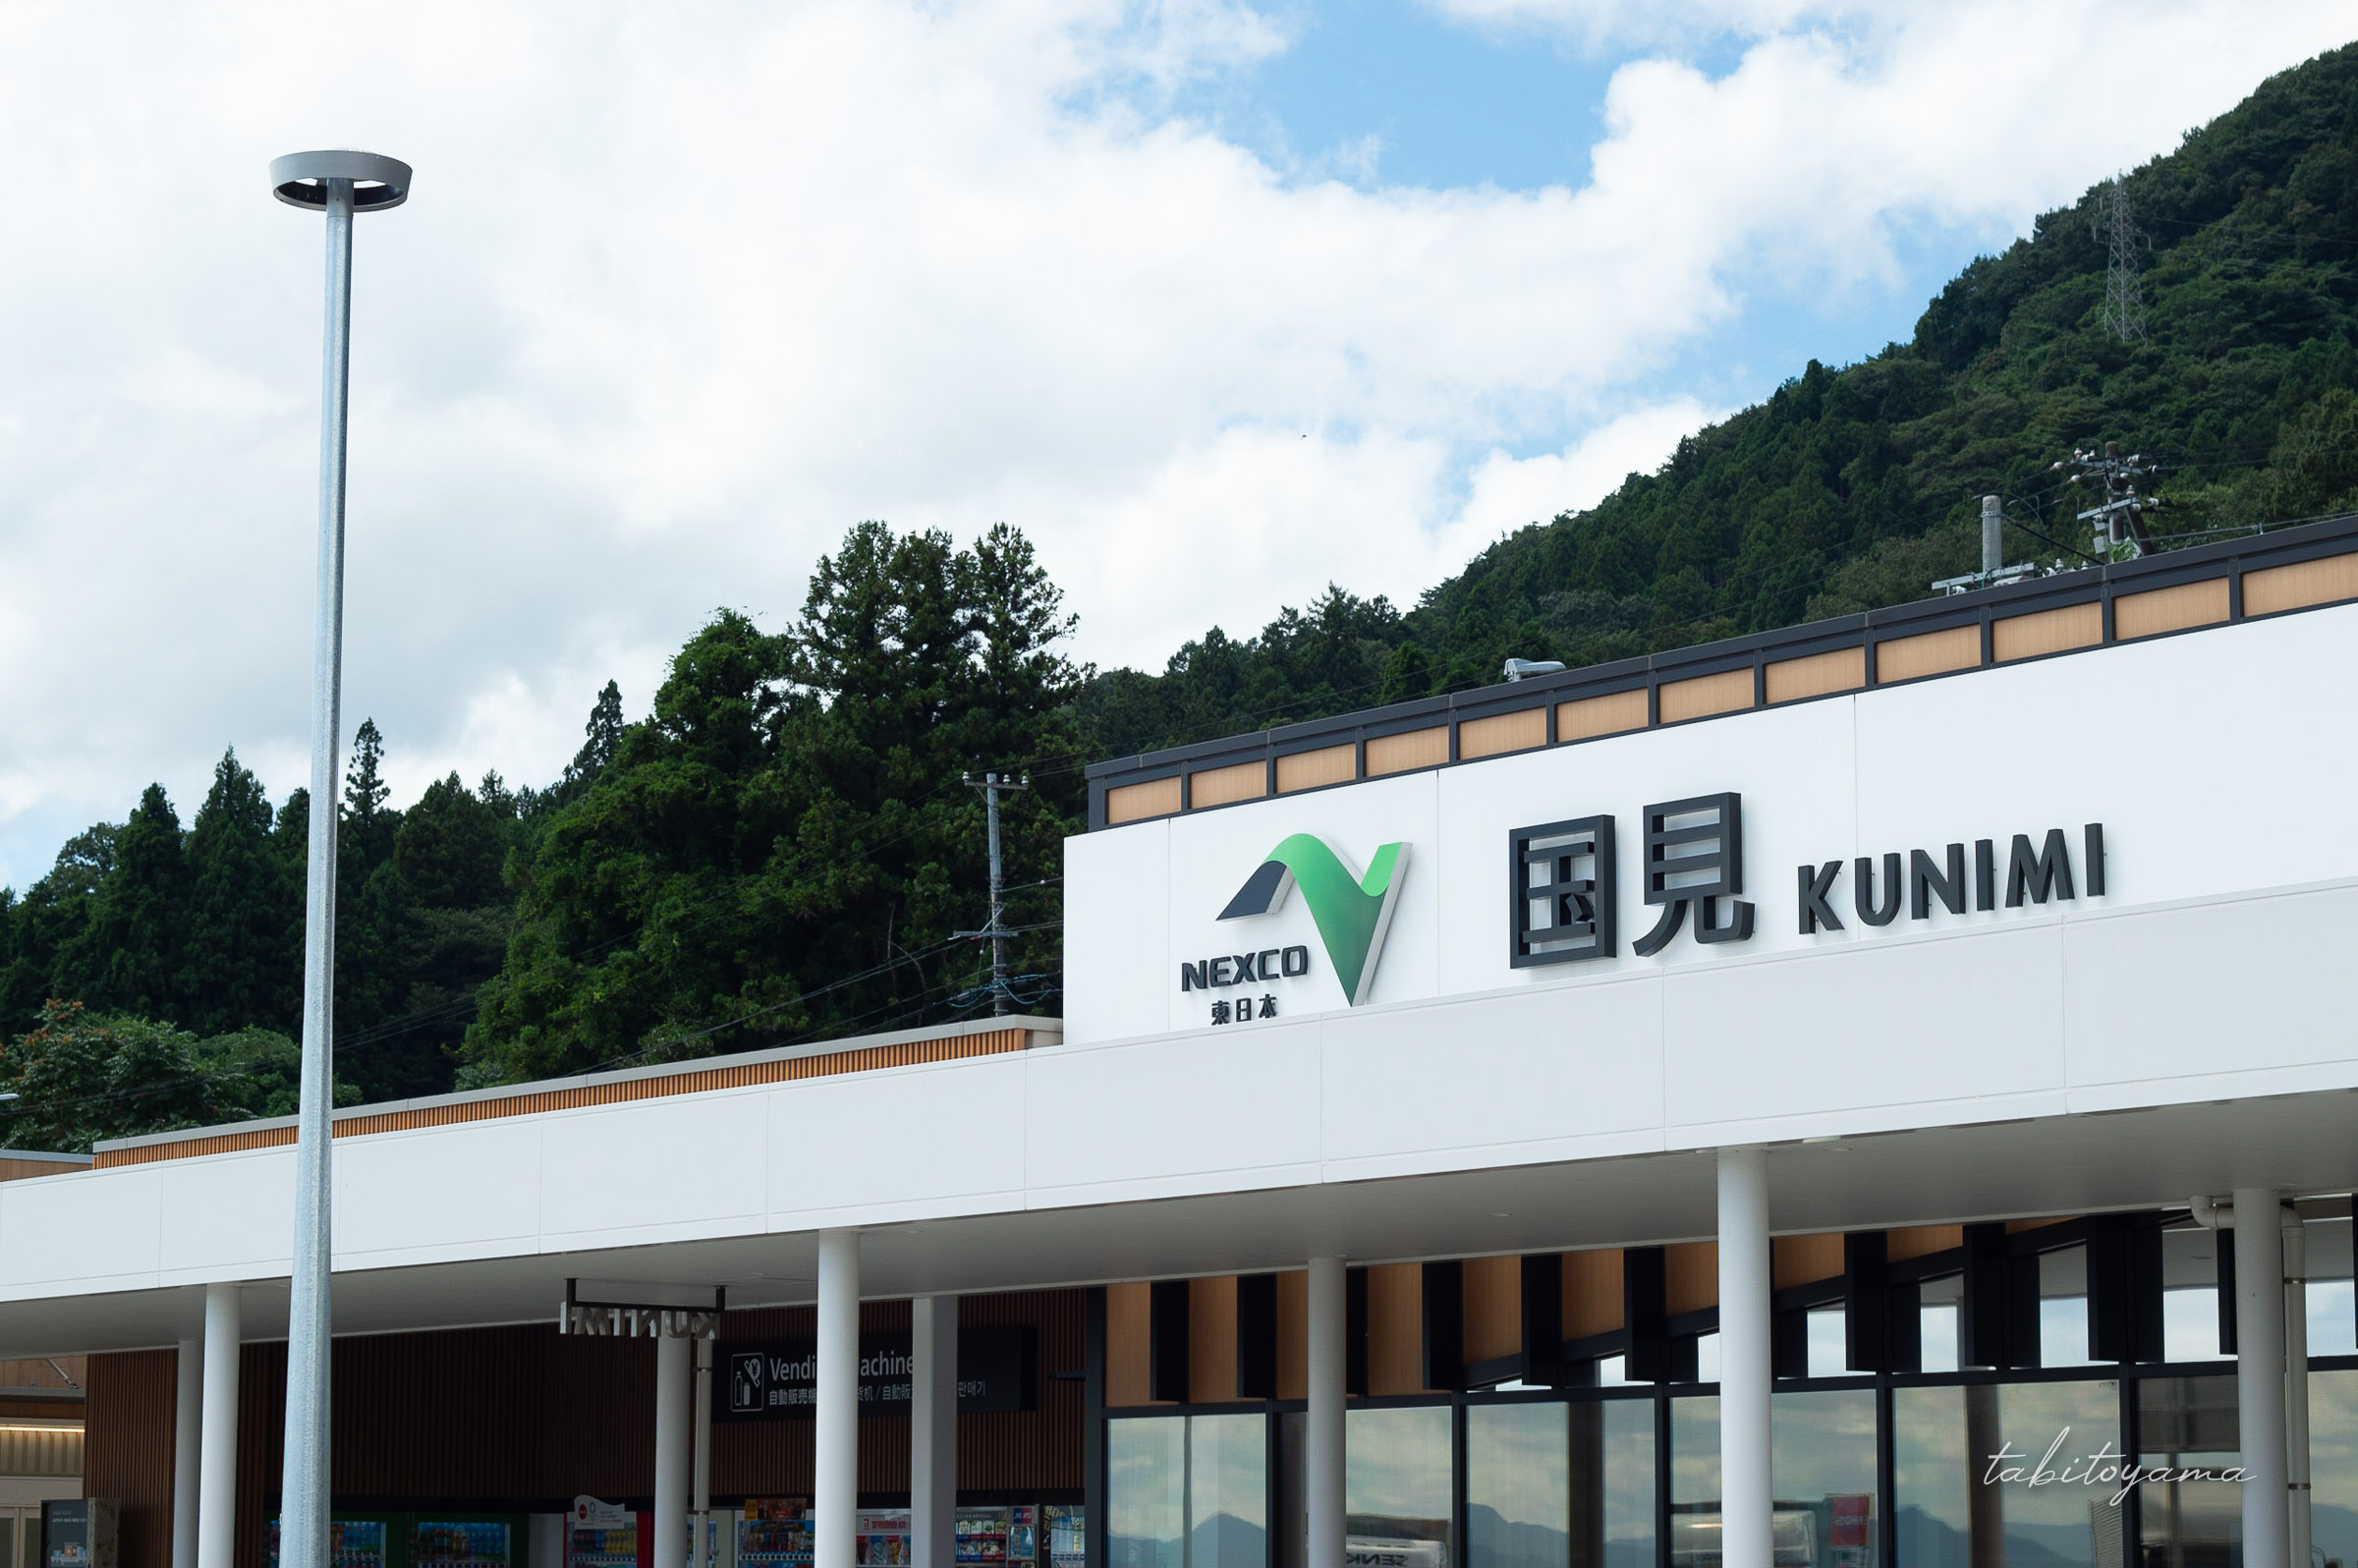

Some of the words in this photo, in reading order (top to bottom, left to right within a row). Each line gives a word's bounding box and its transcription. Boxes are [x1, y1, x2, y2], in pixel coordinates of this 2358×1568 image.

[1509, 792, 1755, 969] 国見
[1797, 822, 2105, 934] KUNIMI
[1181, 944, 1309, 991] NEXCO
[1210, 993, 1279, 1026] 東日本
[769, 1354, 815, 1381] Vendi
